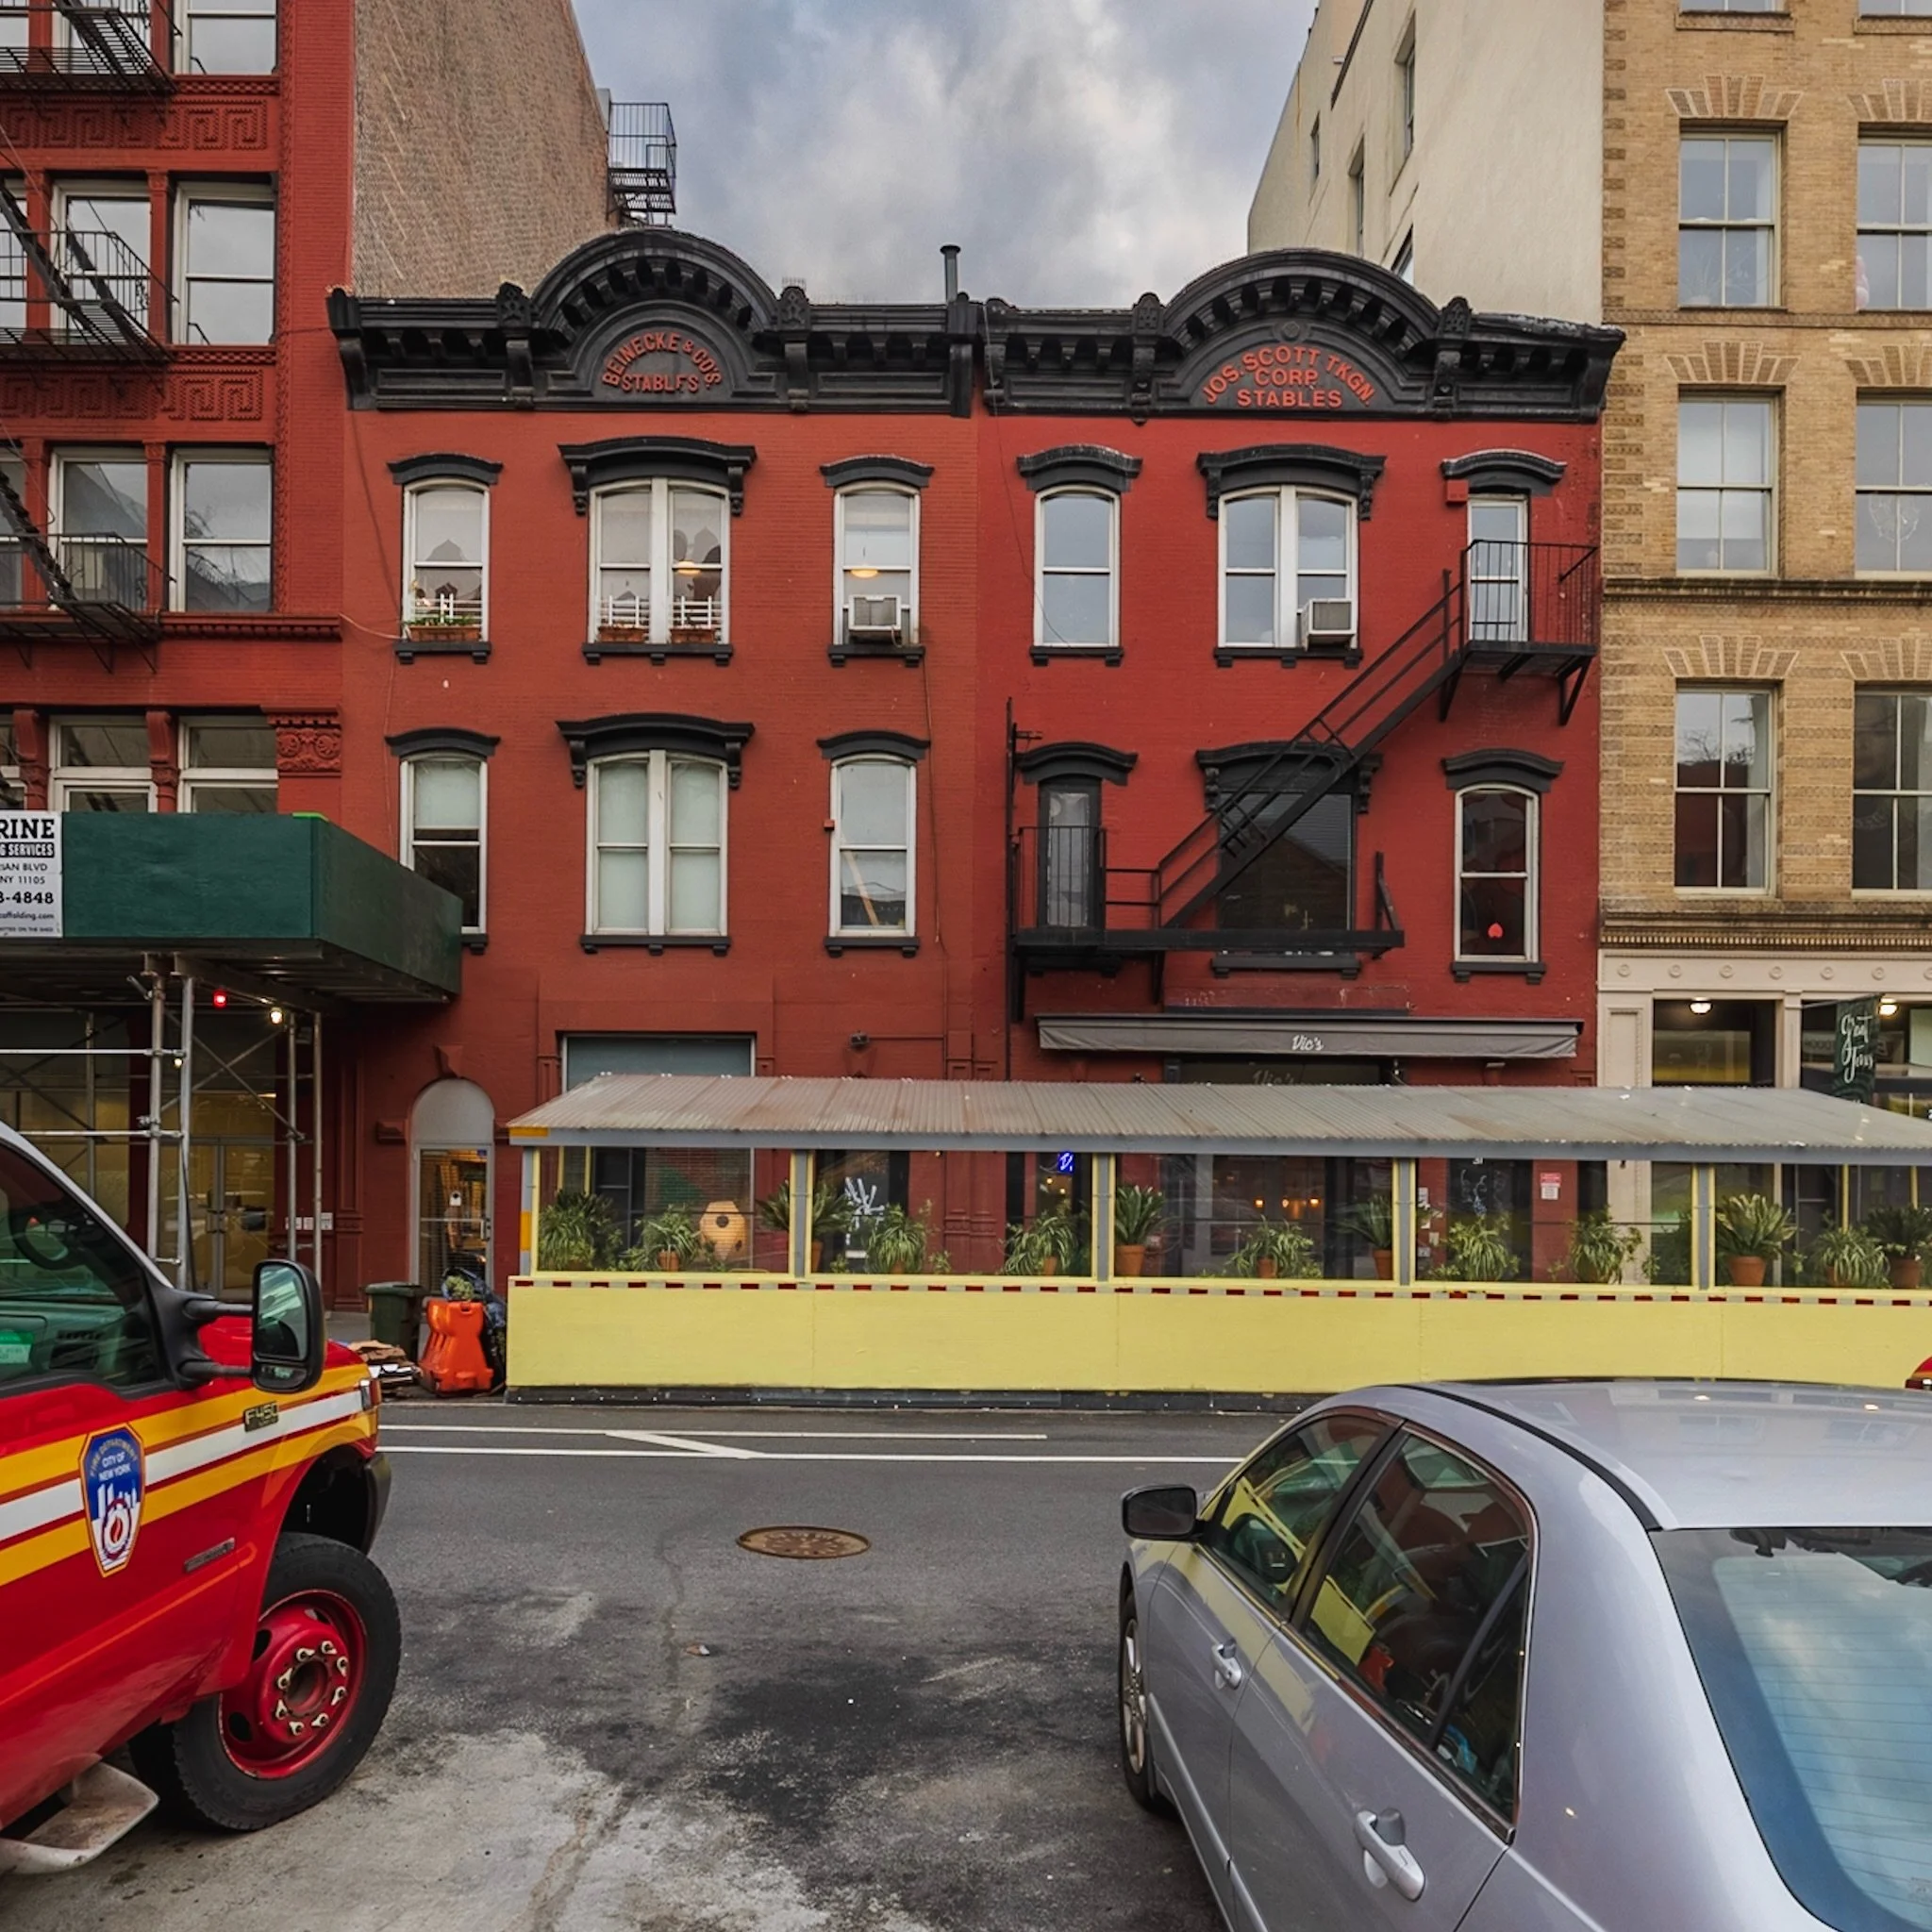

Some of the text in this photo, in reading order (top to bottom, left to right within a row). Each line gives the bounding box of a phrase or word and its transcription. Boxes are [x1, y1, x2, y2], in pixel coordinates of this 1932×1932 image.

[602, 332, 681, 386] BEINECKE
[682, 339, 694, 353] &
[1241, 345, 1320, 371] SCOTT
[1237, 389, 1343, 408] STABLES
[0, 819, 55, 839] RINE
[8, 843, 54, 857] SERVICES
[19, 875, 45, 884] 11105
[1291, 1034, 1324, 1051] Vic's
[102, 1451, 125, 1469] CITY OF
[98, 1462, 131, 1481] NEW YORK
